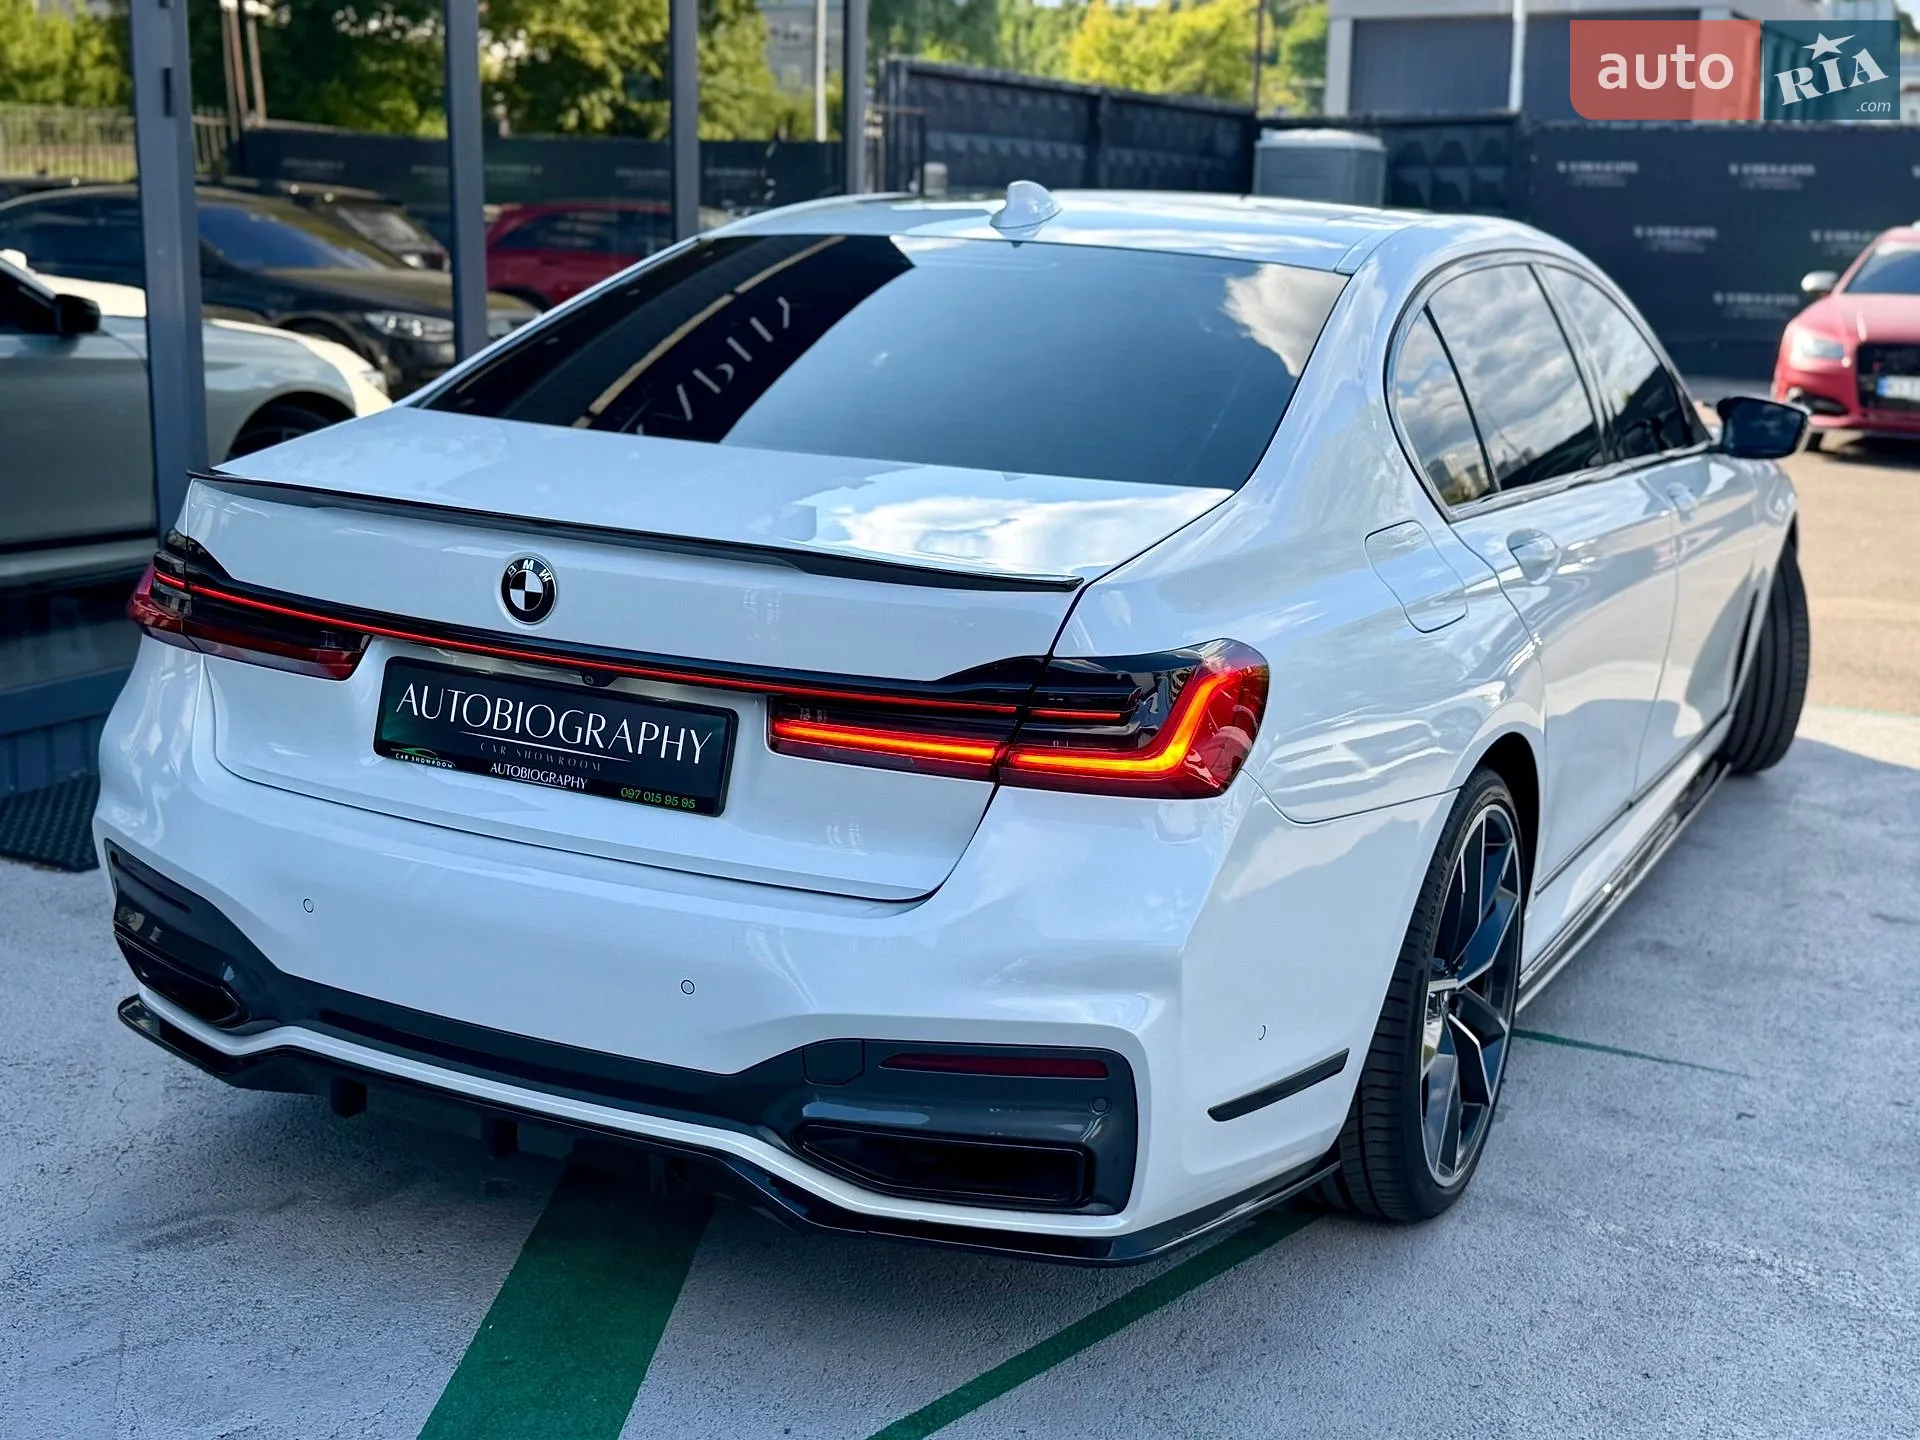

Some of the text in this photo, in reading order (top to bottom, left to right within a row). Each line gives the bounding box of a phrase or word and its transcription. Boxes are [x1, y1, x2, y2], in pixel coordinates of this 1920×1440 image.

[507, 559, 552, 583] BMW
[395, 682, 713, 764] AUTOBIOGRAPHY
[411, 756, 453, 769] SHOWROOM
[480, 742, 600, 772] CAR SHOWROOM
[489, 762, 588, 790] AUTOBIOGRAPHY
[620, 787, 696, 809] 097 015 95 95
